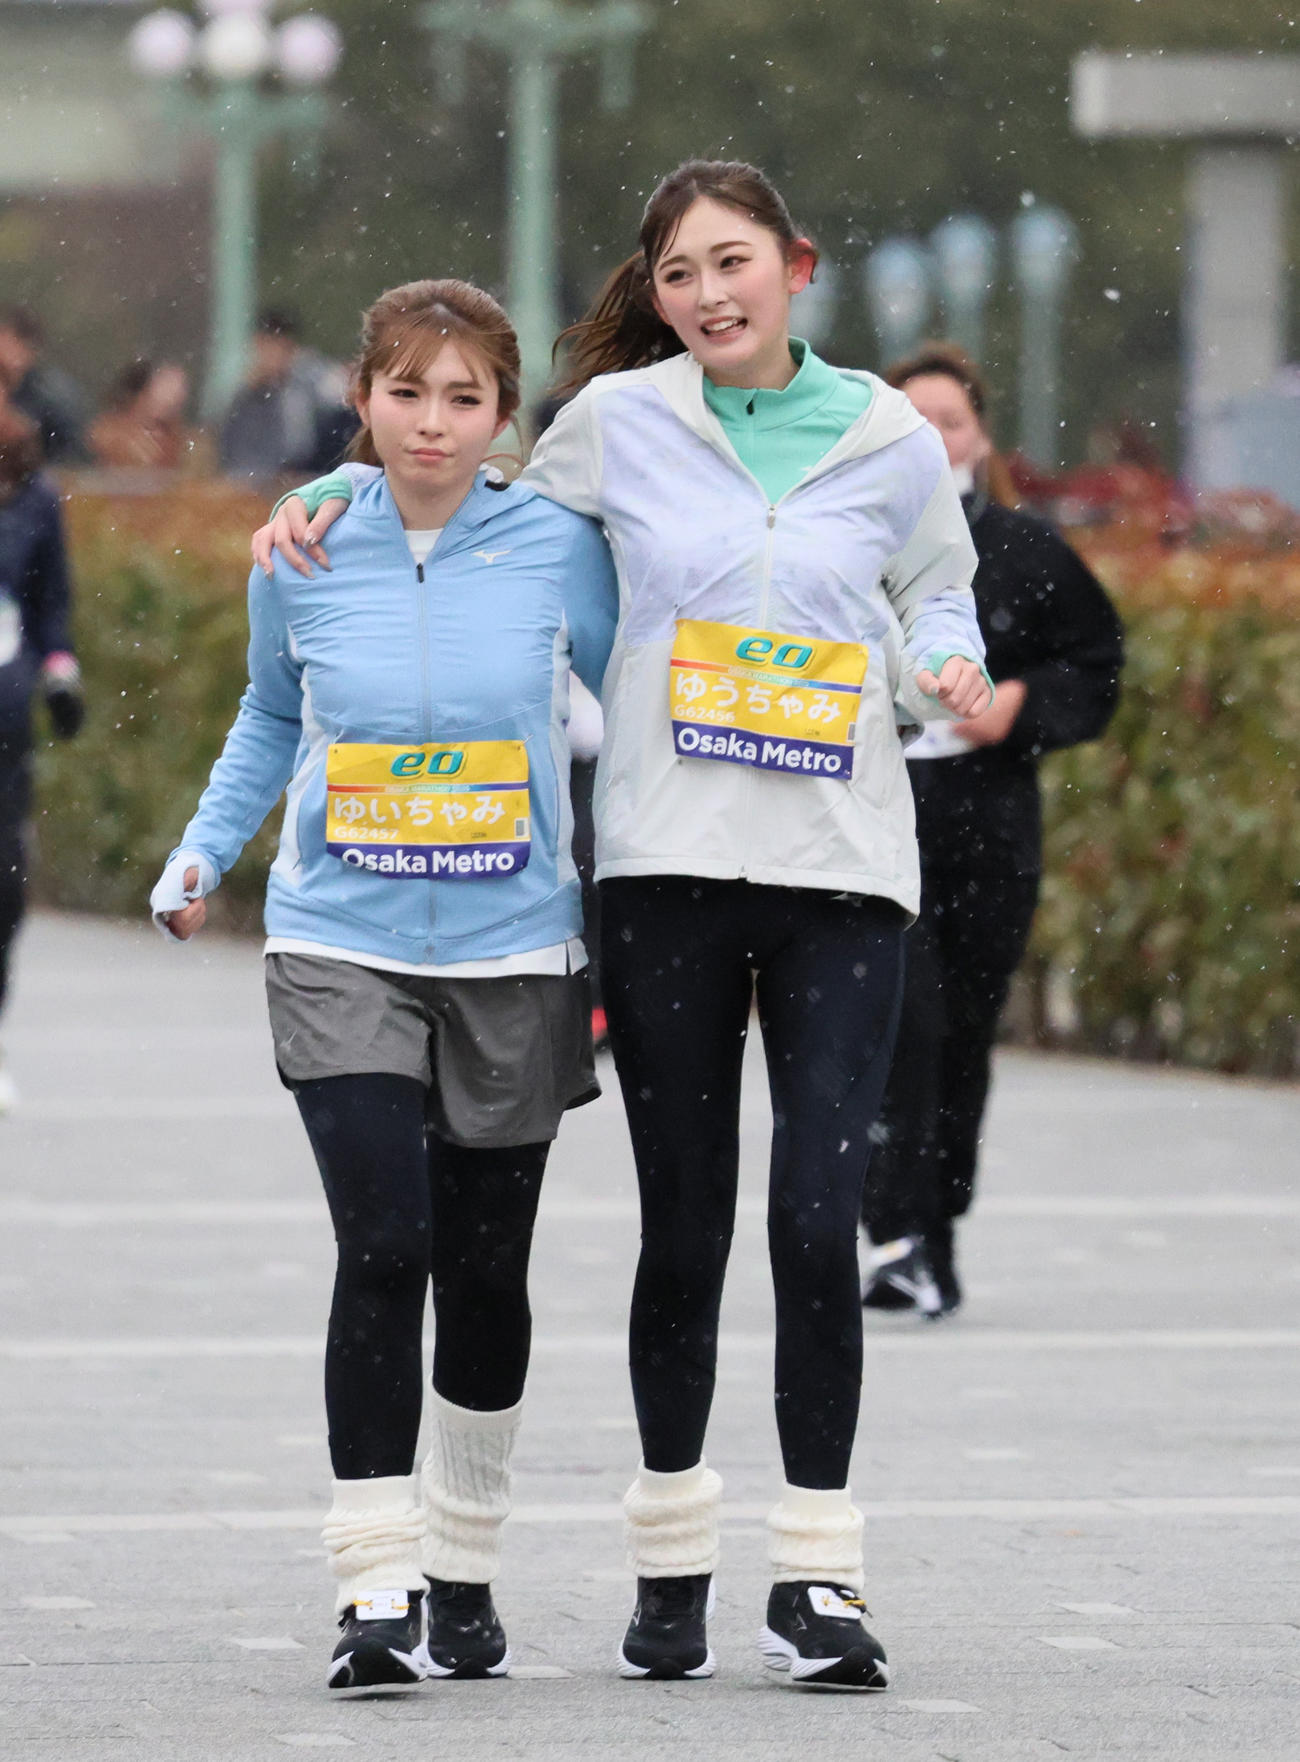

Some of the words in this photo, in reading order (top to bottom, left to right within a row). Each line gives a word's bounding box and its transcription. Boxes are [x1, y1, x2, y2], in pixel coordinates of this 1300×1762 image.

[736, 636, 813, 668] eo
[675, 672, 841, 724] ゆうちゃみ
[674, 703, 736, 723] G62456
[390, 750, 464, 777] eo
[678, 727, 758, 761] Osaka
[761, 741, 842, 773] Metro
[334, 795, 506, 826] ゆいちゃみ
[334, 825, 399, 839] G62457
[342, 848, 427, 873] Osaka
[432, 850, 515, 873] Metro
